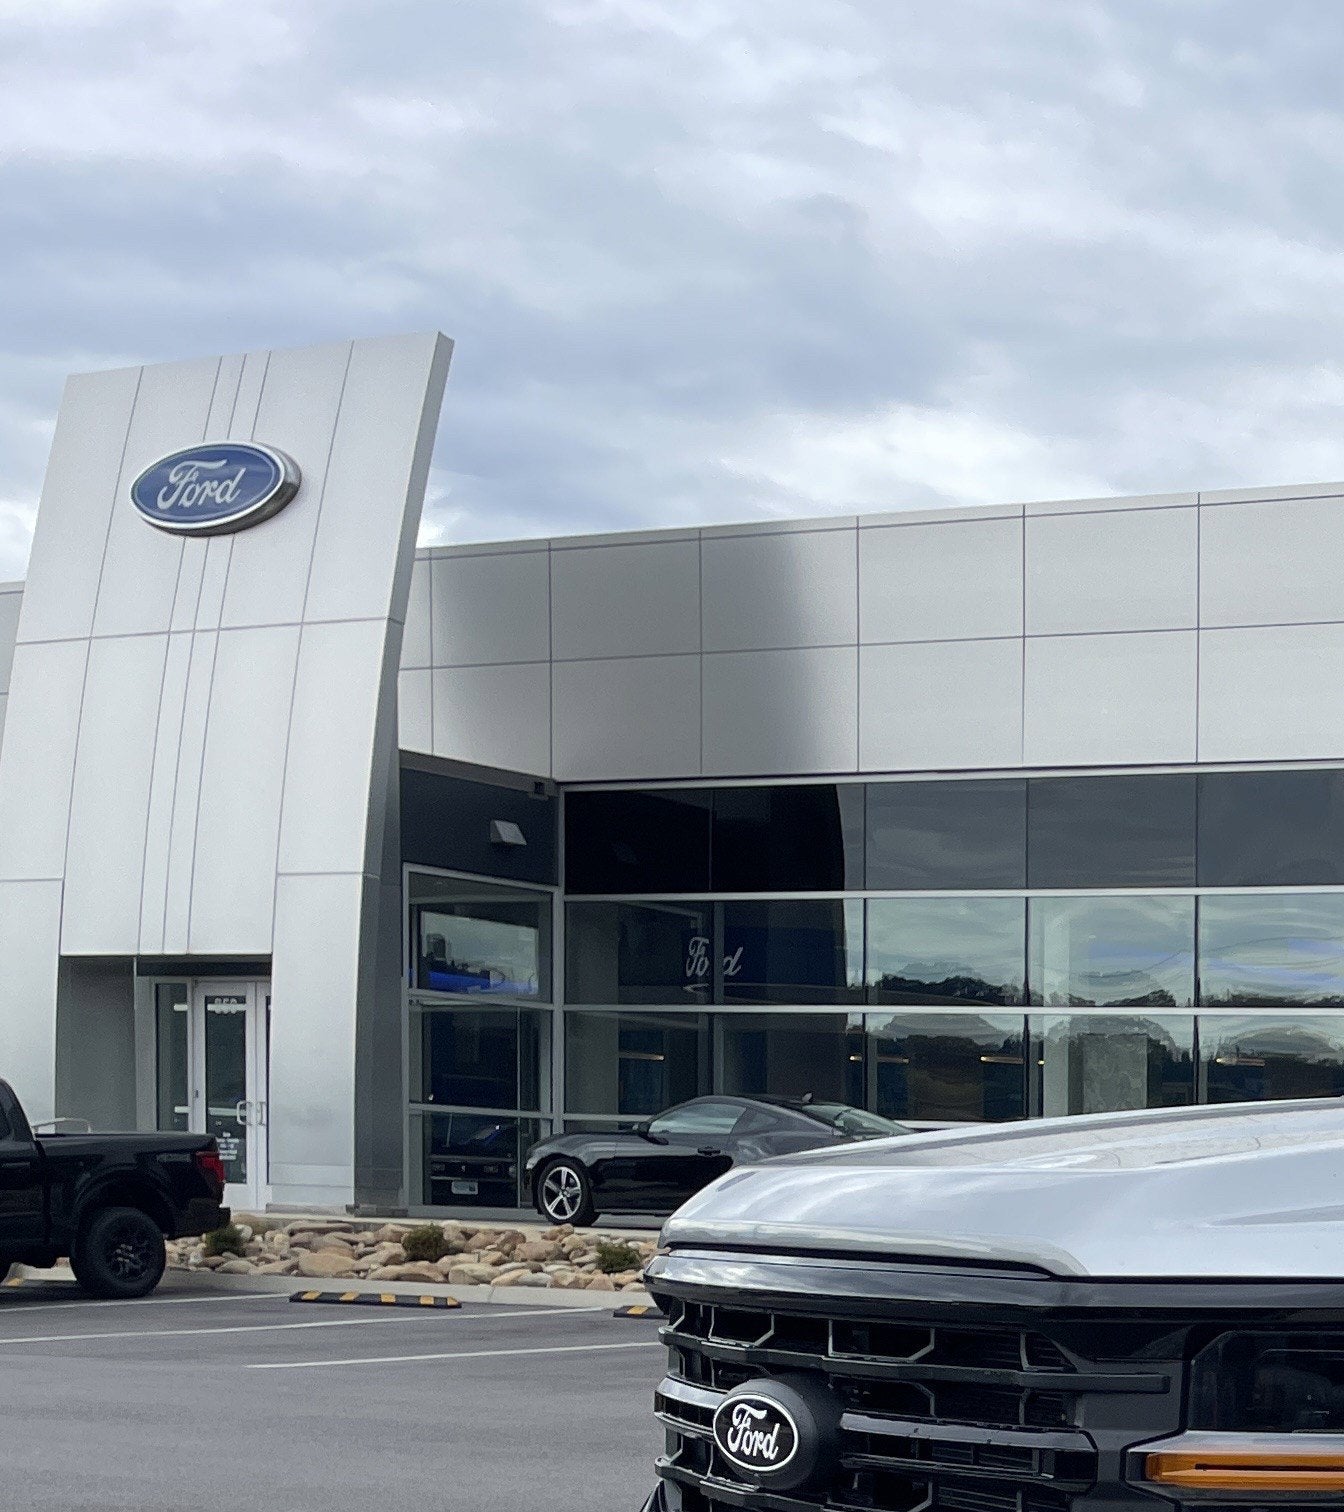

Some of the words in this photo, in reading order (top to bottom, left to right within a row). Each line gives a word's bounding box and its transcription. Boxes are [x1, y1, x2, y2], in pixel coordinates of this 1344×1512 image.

[157, 458, 247, 510] Ford
[685, 936, 744, 977] Fod
[727, 1402, 780, 1460] Ford
